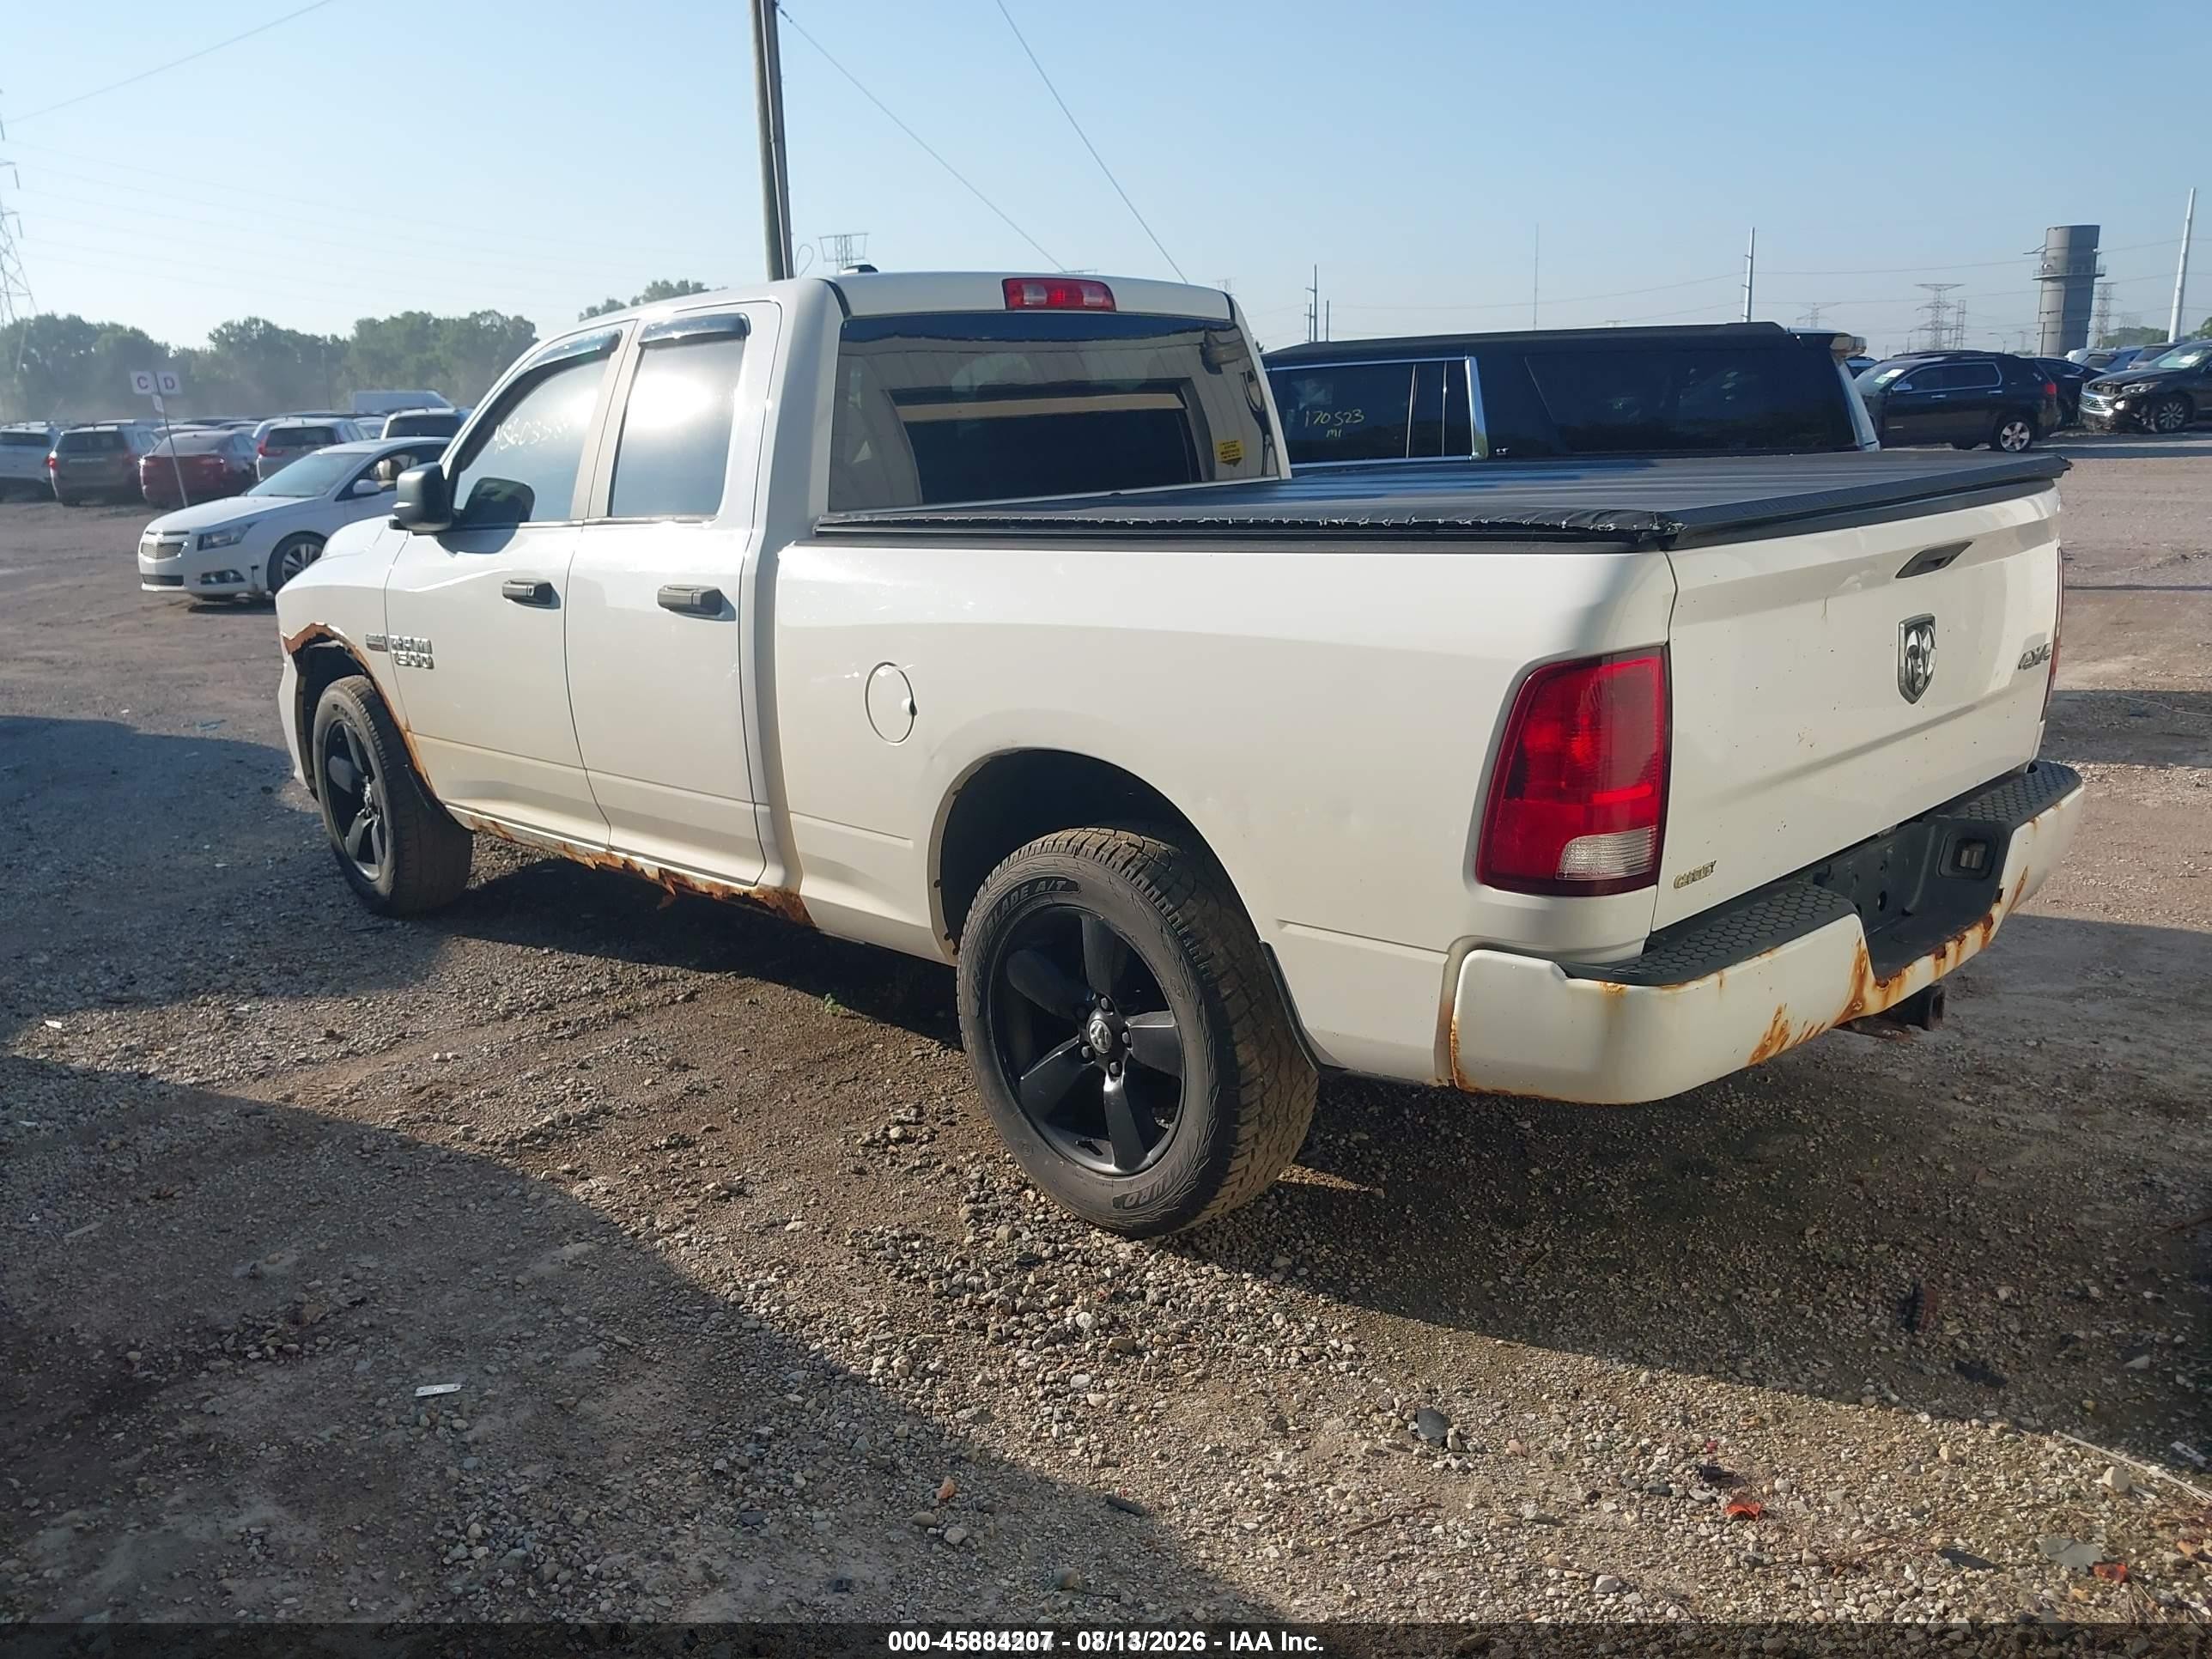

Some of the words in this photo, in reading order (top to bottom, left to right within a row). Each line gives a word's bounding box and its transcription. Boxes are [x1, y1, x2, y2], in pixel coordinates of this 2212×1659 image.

[137, 375, 149, 390] C
[163, 376, 176, 390] D
[389, 635, 433, 654] RAM
[1035, 879, 1066, 894] A/T
